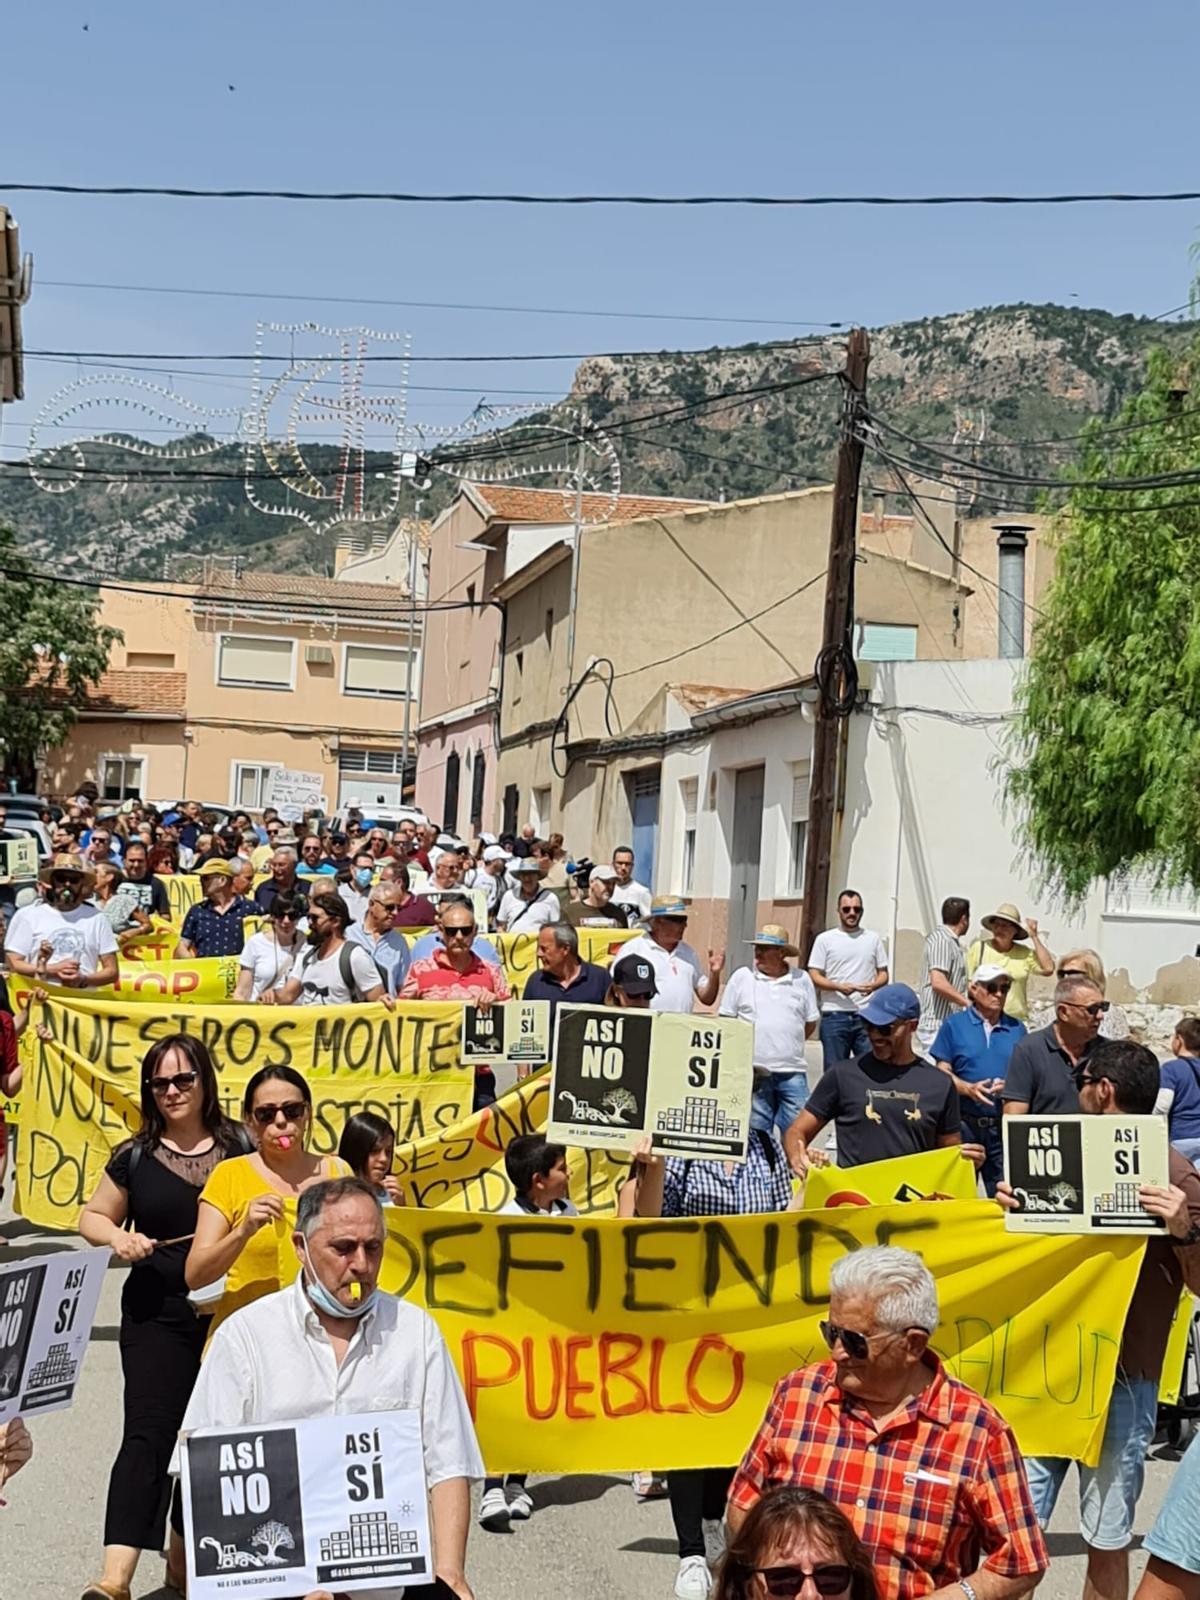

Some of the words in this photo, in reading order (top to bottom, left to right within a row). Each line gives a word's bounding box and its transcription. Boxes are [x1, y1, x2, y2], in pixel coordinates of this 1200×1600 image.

[475, 1019, 494, 1036] NO
[583, 1018, 624, 1044] ASÍ
[690, 1029, 722, 1049] ASÍ
[581, 1045, 624, 1080] NO
[687, 1053, 722, 1089] SÍ
[1028, 1123, 1060, 1147] ASÍ
[1114, 1125, 1139, 1143] ASÍ
[1028, 1148, 1063, 1177] NO
[1114, 1145, 1140, 1175] SÍ
[4, 1271, 32, 1308] ASÍ
[64, 1263, 88, 1291] ASÍ
[54, 1289, 81, 1335] SÍ
[460, 1330, 745, 1424] PUEBLO
[219, 1436, 265, 1472] ASÍ
[344, 1428, 381, 1456] ASÍ
[346, 1455, 385, 1502] SÍ
[220, 1472, 271, 1517] NO
